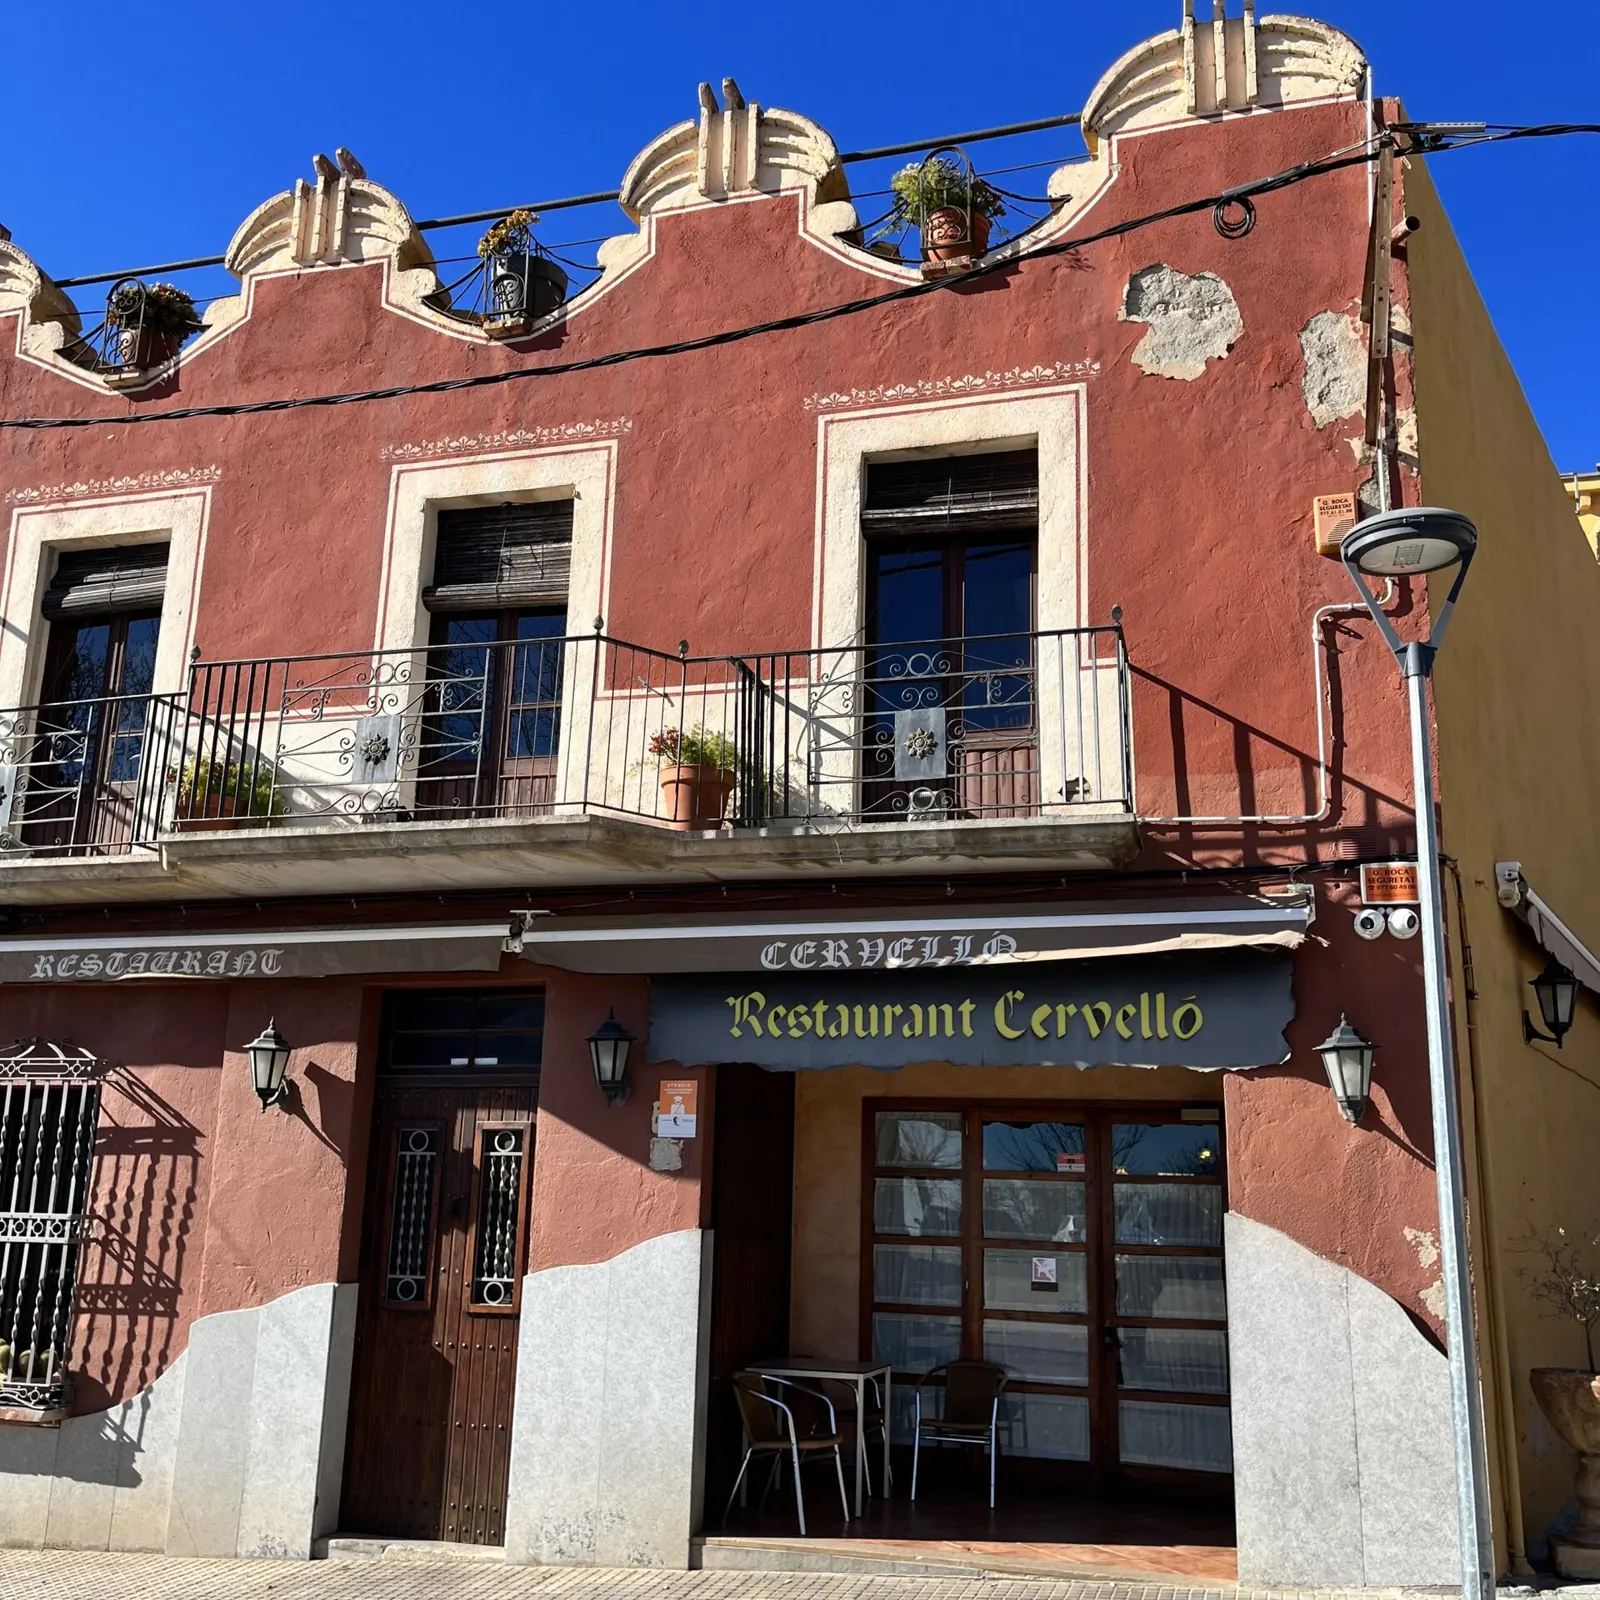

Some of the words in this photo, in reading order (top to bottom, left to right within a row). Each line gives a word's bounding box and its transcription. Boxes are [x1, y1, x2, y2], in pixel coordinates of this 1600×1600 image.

[1319, 503, 1352, 511] SEGURETAT
[1384, 868, 1410, 876] ROCA
[1367, 876, 1415, 884] SEGURETAT
[29, 949, 285, 979] RESTAURANT
[725, 991, 976, 1038] Restaurant
[994, 990, 1204, 1040] Cervelló
